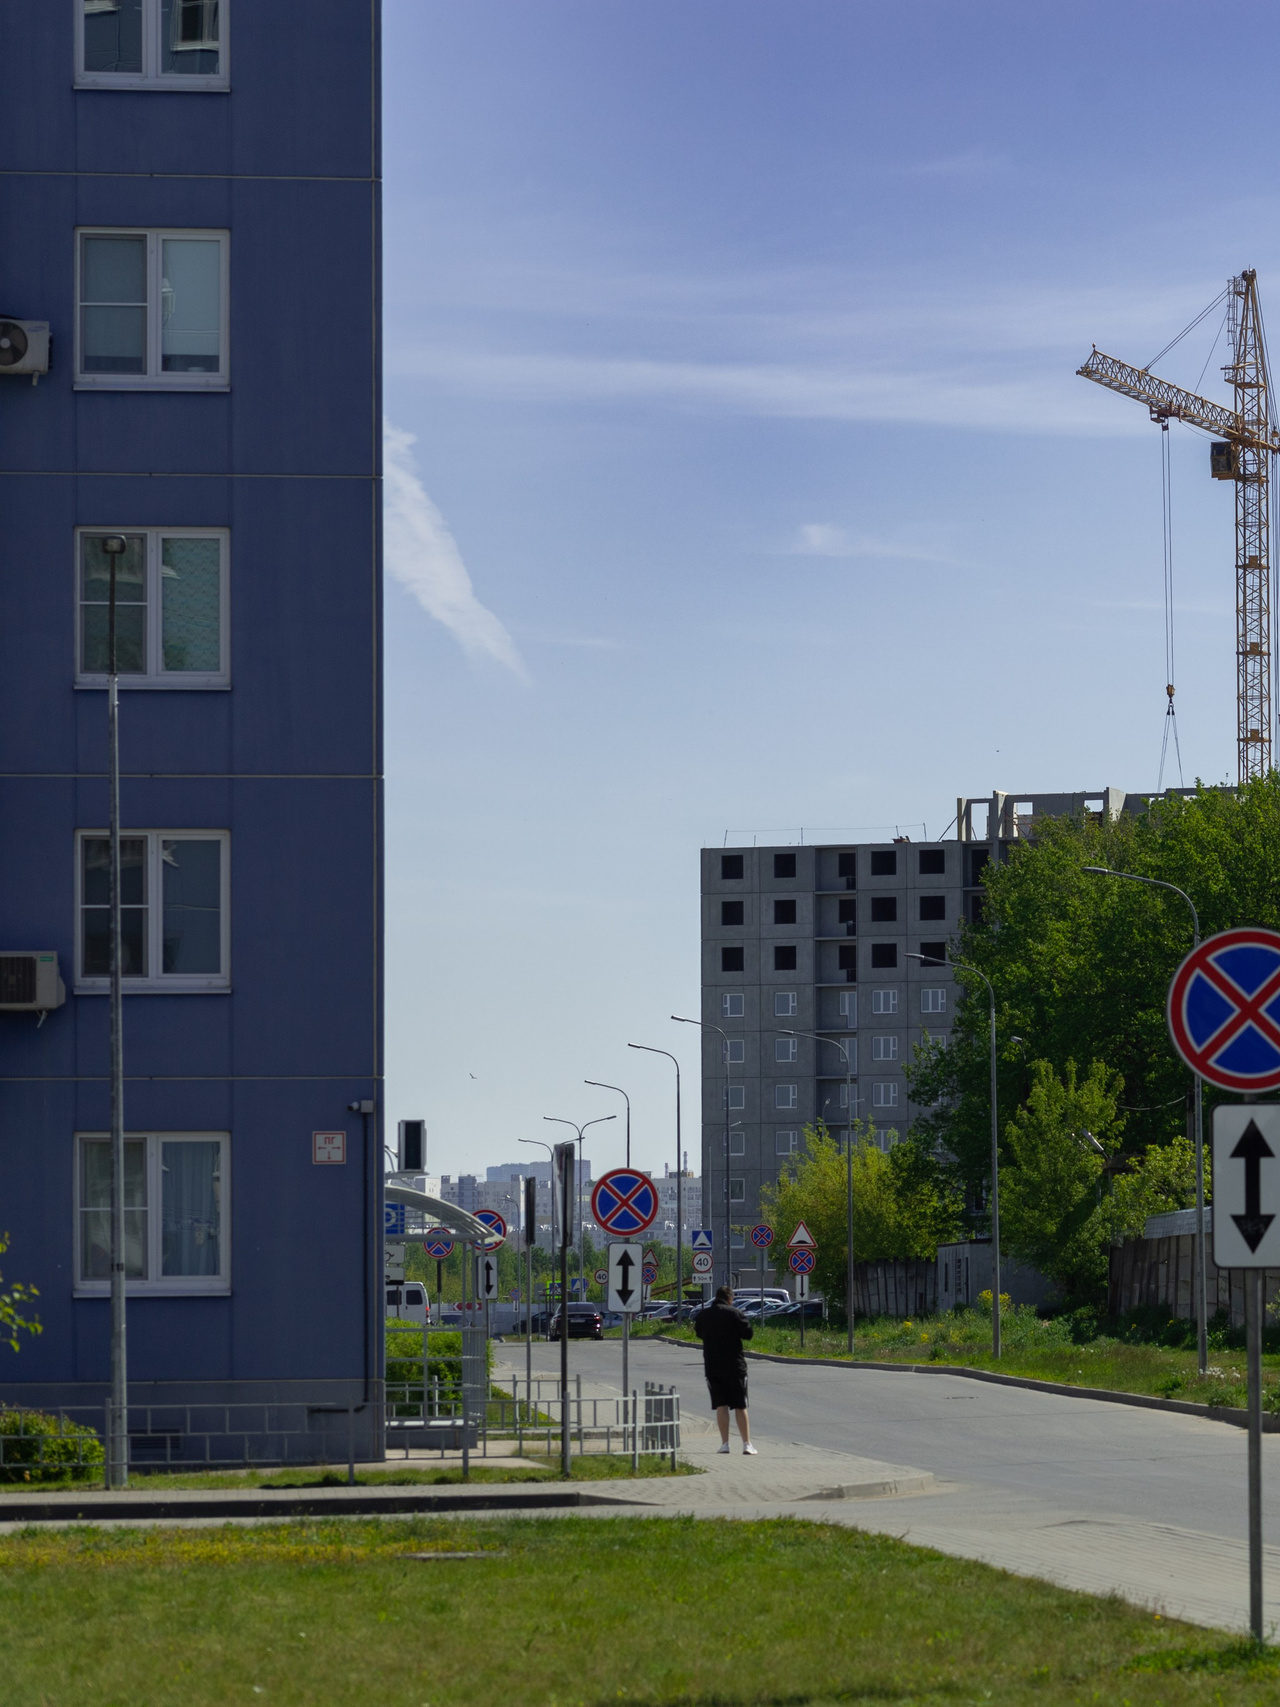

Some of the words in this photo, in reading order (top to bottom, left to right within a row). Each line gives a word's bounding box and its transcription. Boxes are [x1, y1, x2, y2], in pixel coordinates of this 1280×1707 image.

[324, 1136, 336, 1144] ПГ
[696, 1257, 709, 1266] 40
[596, 1273, 607, 1281] 40
